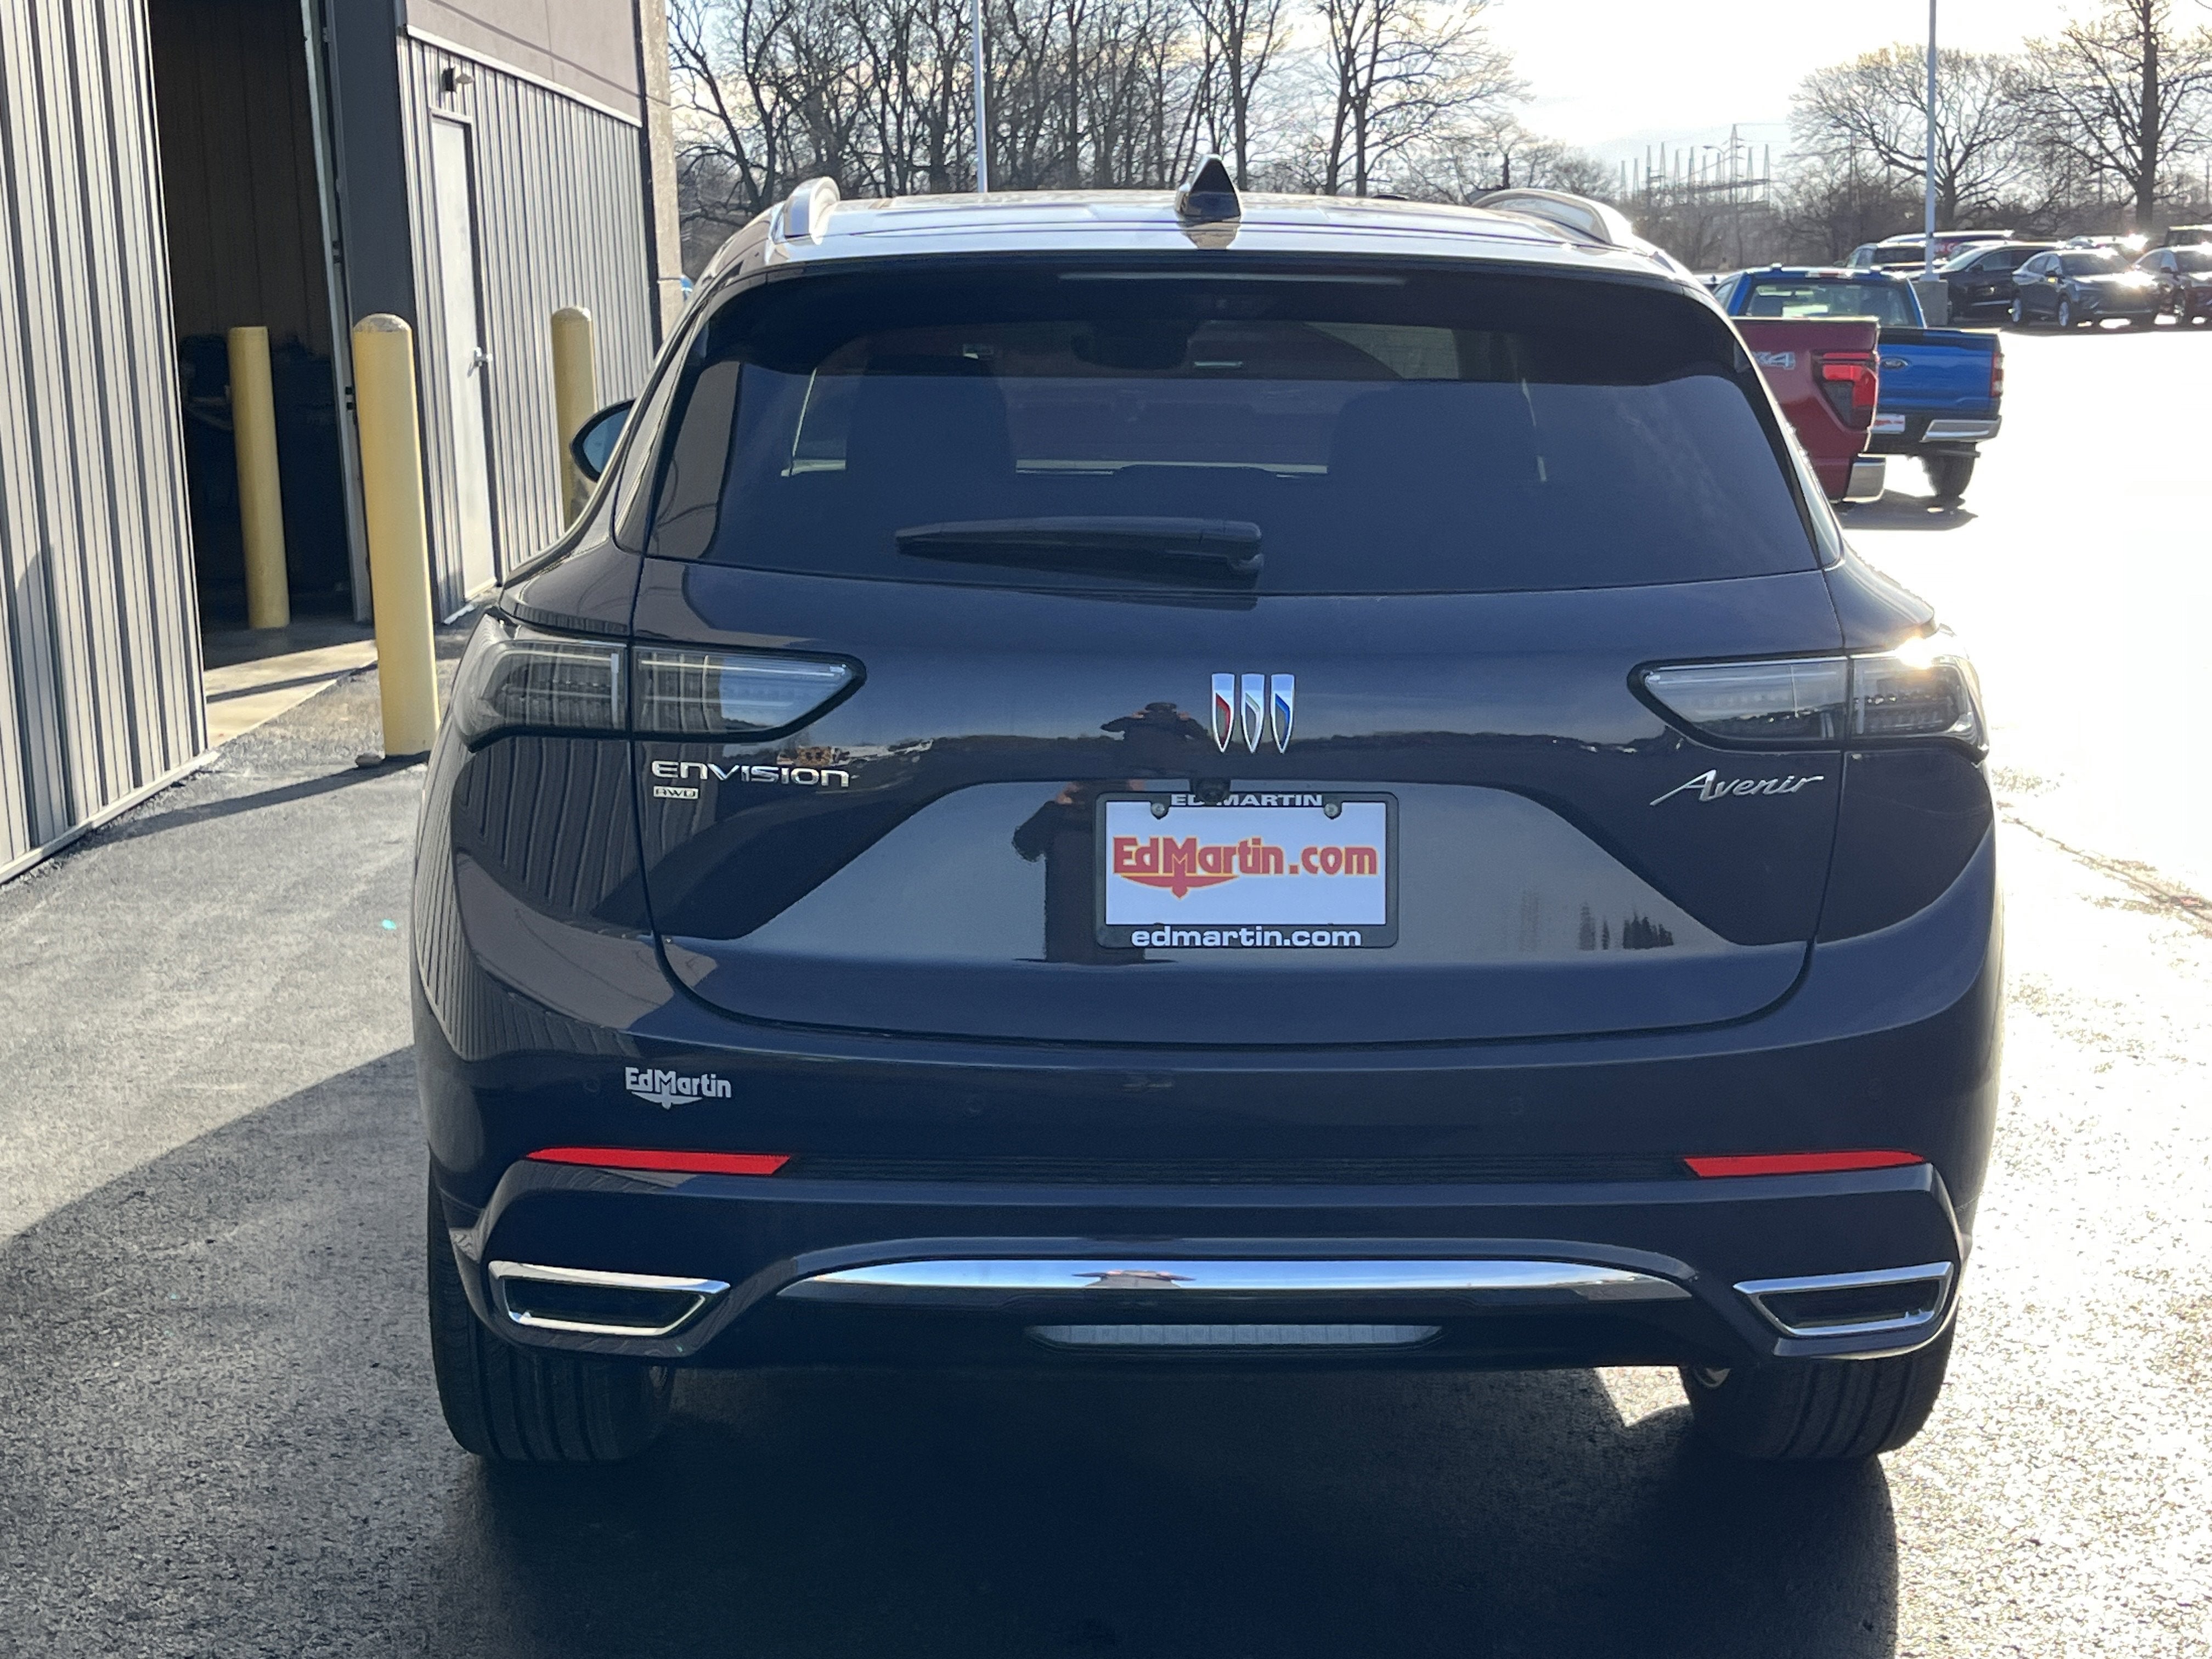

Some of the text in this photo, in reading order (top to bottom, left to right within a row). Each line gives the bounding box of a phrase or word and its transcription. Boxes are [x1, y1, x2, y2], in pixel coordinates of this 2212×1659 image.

[655, 788, 696, 797] AWD
[1650, 769, 1824, 806] Avenir
[1113, 836, 1378, 876] EdMartin.com
[1131, 926, 1361, 947] edmartin.com
[625, 1066, 732, 1098] EdMartin
